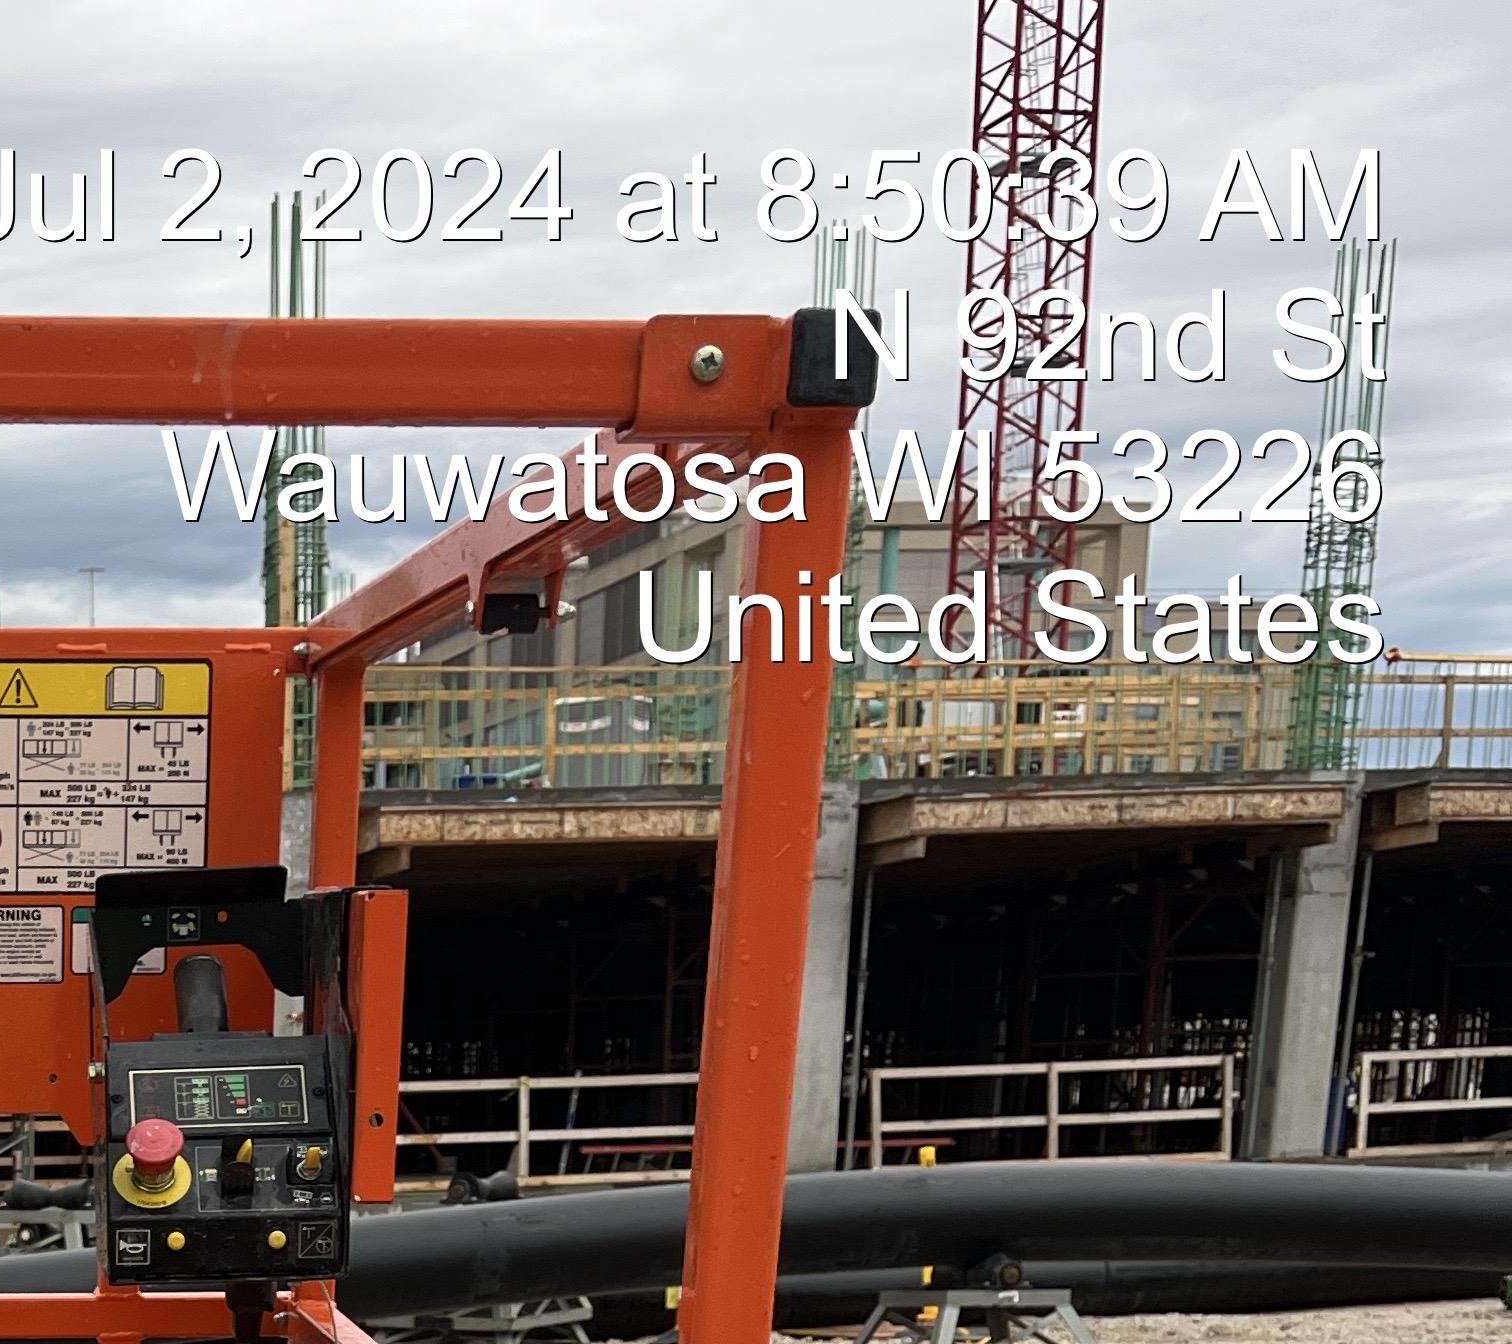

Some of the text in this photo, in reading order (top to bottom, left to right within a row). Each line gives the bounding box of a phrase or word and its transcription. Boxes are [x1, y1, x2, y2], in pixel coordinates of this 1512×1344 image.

[85, 784, 97, 792] LB
[139, 784, 151, 792] LB
[40, 790, 61, 798] MAX
[84, 795, 96, 804] kg
[138, 795, 150, 804] kg
[84, 870, 95, 878] LB
[37, 876, 58, 884] MAX
[84, 881, 95, 889] kg
